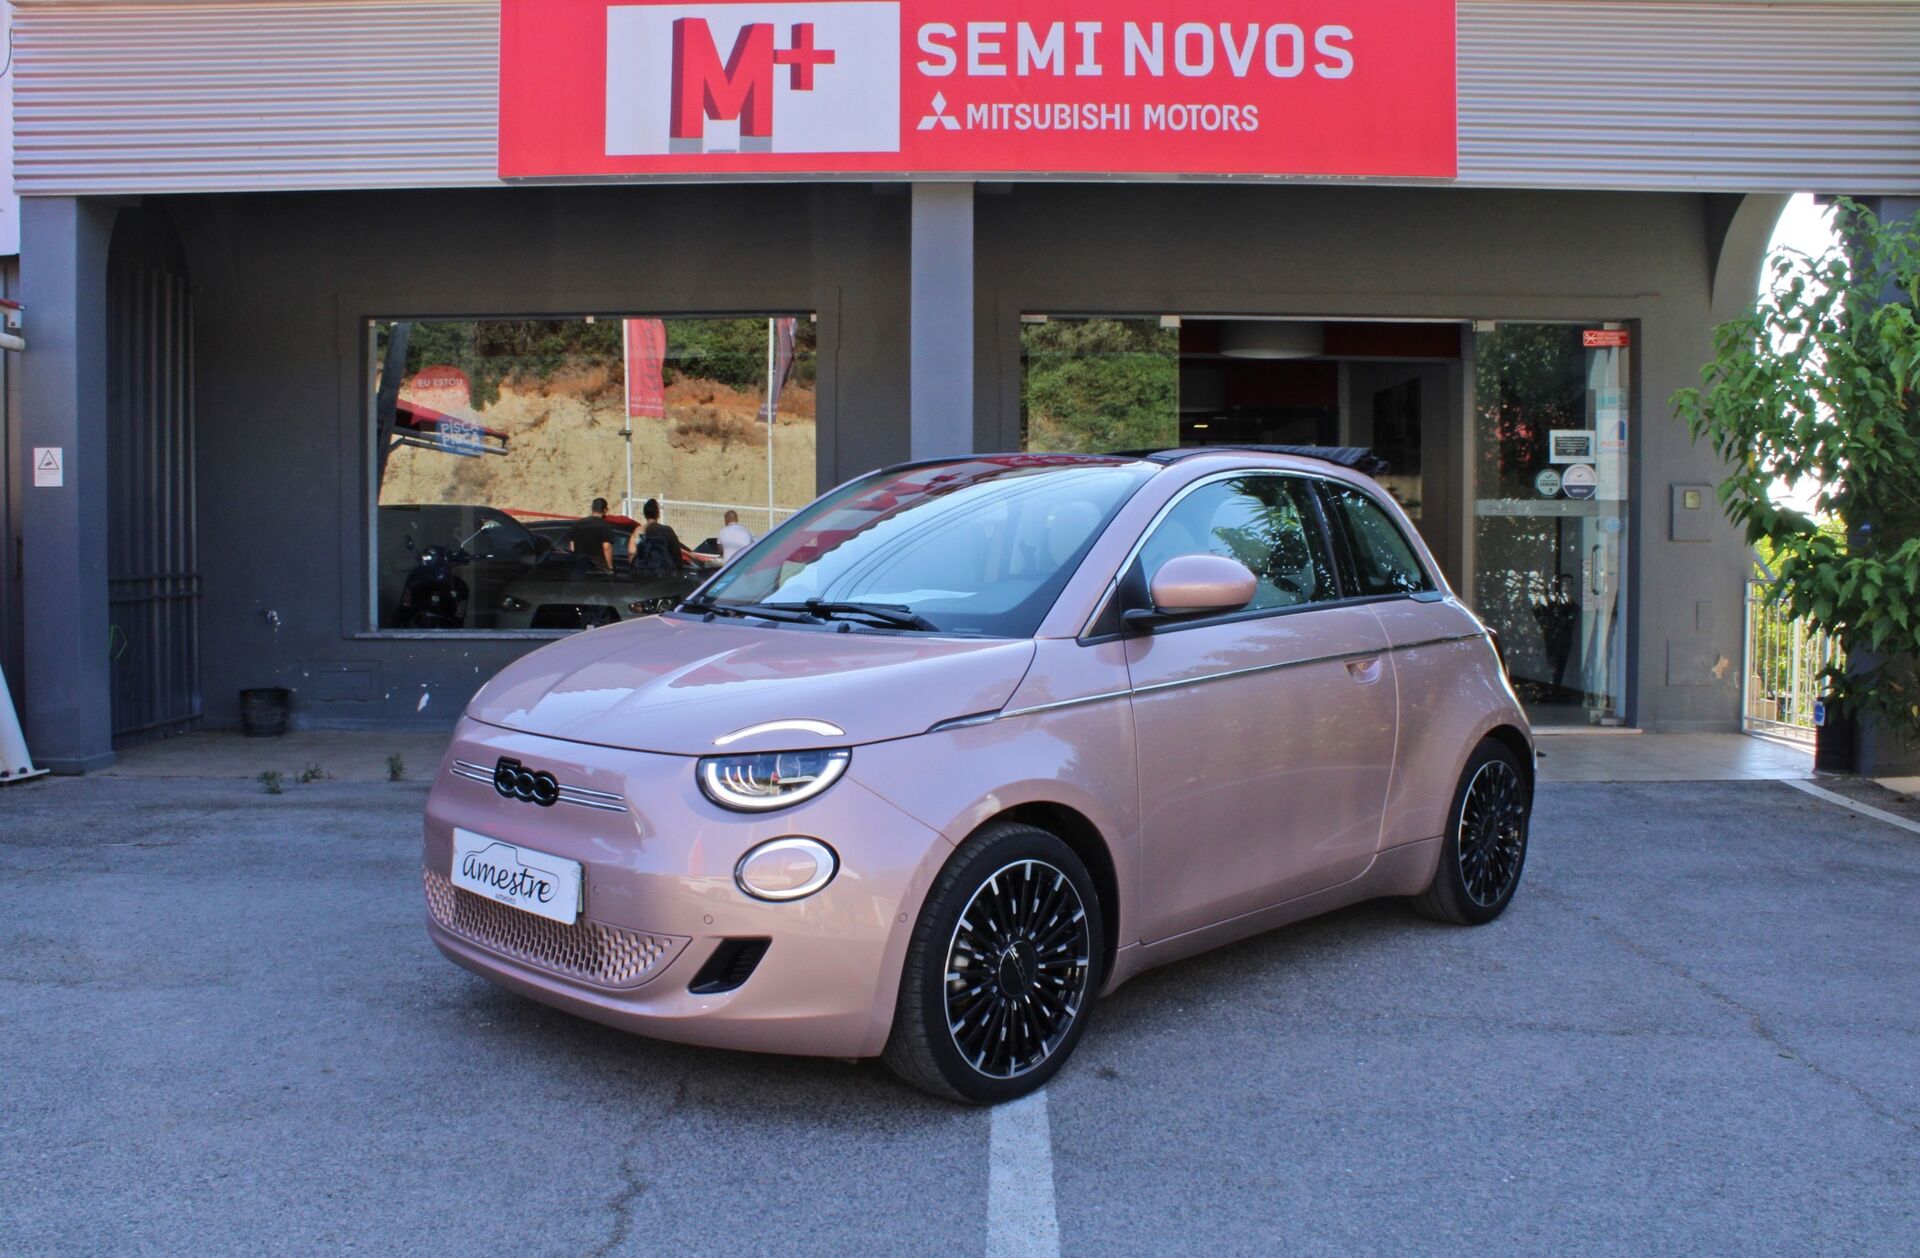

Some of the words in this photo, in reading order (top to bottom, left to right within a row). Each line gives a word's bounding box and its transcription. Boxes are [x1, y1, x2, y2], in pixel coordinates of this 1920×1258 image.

[916, 21, 1102, 77] SEMI
[1123, 21, 1355, 80] NOVOS
[966, 102, 1130, 131] MITSUBISHI
[1143, 103, 1260, 132] MOTORS
[417, 378, 431, 388] EU
[433, 377, 463, 387] ESTOU
[493, 755, 560, 807] 500
[462, 853, 552, 904] amestre
